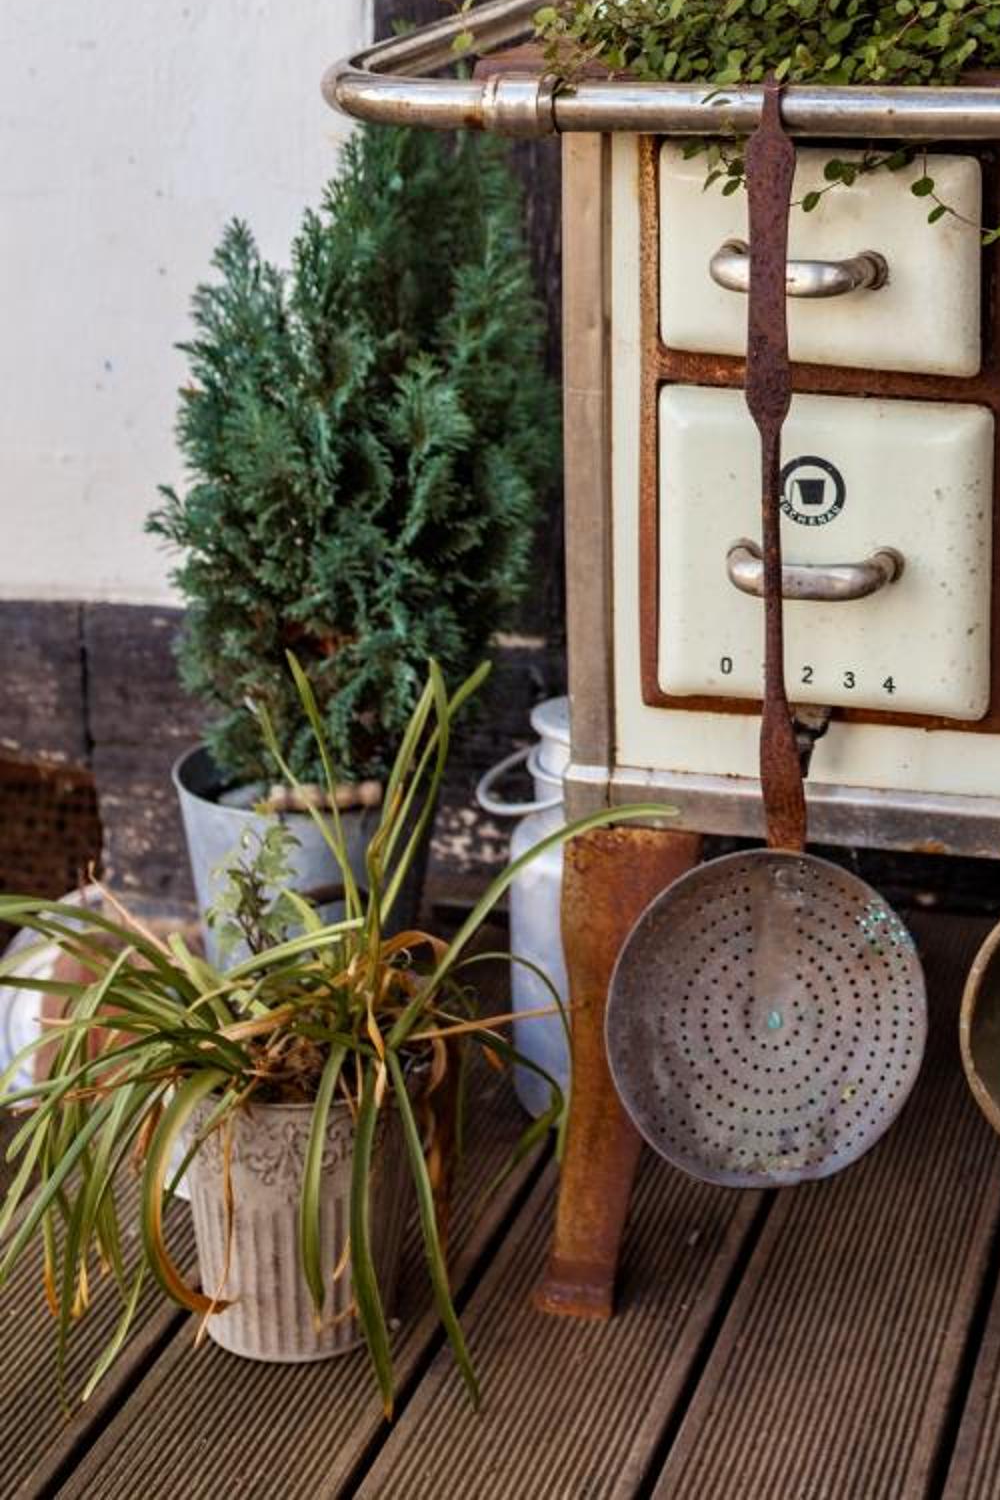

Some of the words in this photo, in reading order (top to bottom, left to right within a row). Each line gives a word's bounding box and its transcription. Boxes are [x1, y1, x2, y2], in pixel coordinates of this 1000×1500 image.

[720, 657, 733, 675] 0
[801, 666, 814, 685] 2
[843, 671, 856, 690] 3
[882, 676, 897, 694] 4
